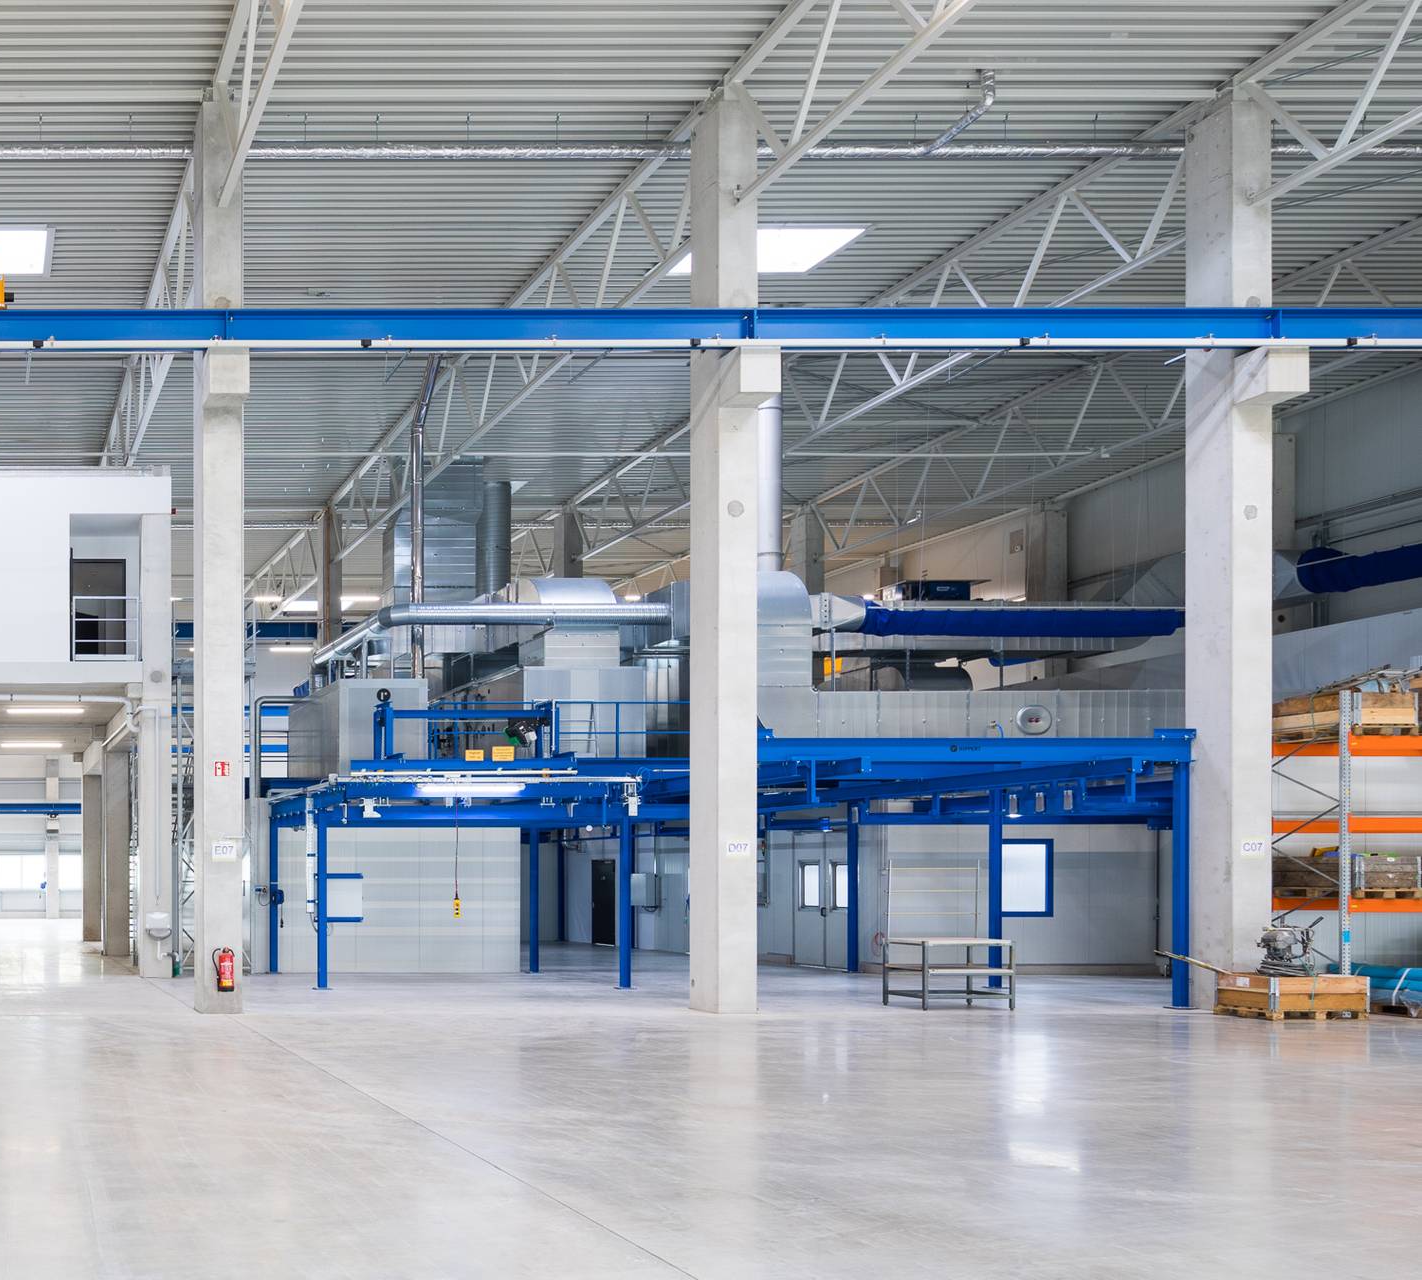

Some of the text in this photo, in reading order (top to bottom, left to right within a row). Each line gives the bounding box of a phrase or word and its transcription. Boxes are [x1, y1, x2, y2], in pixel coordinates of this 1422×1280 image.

[214, 845, 234, 855] E07
[728, 843, 749, 853] D07
[1242, 842, 1263, 852] C07
